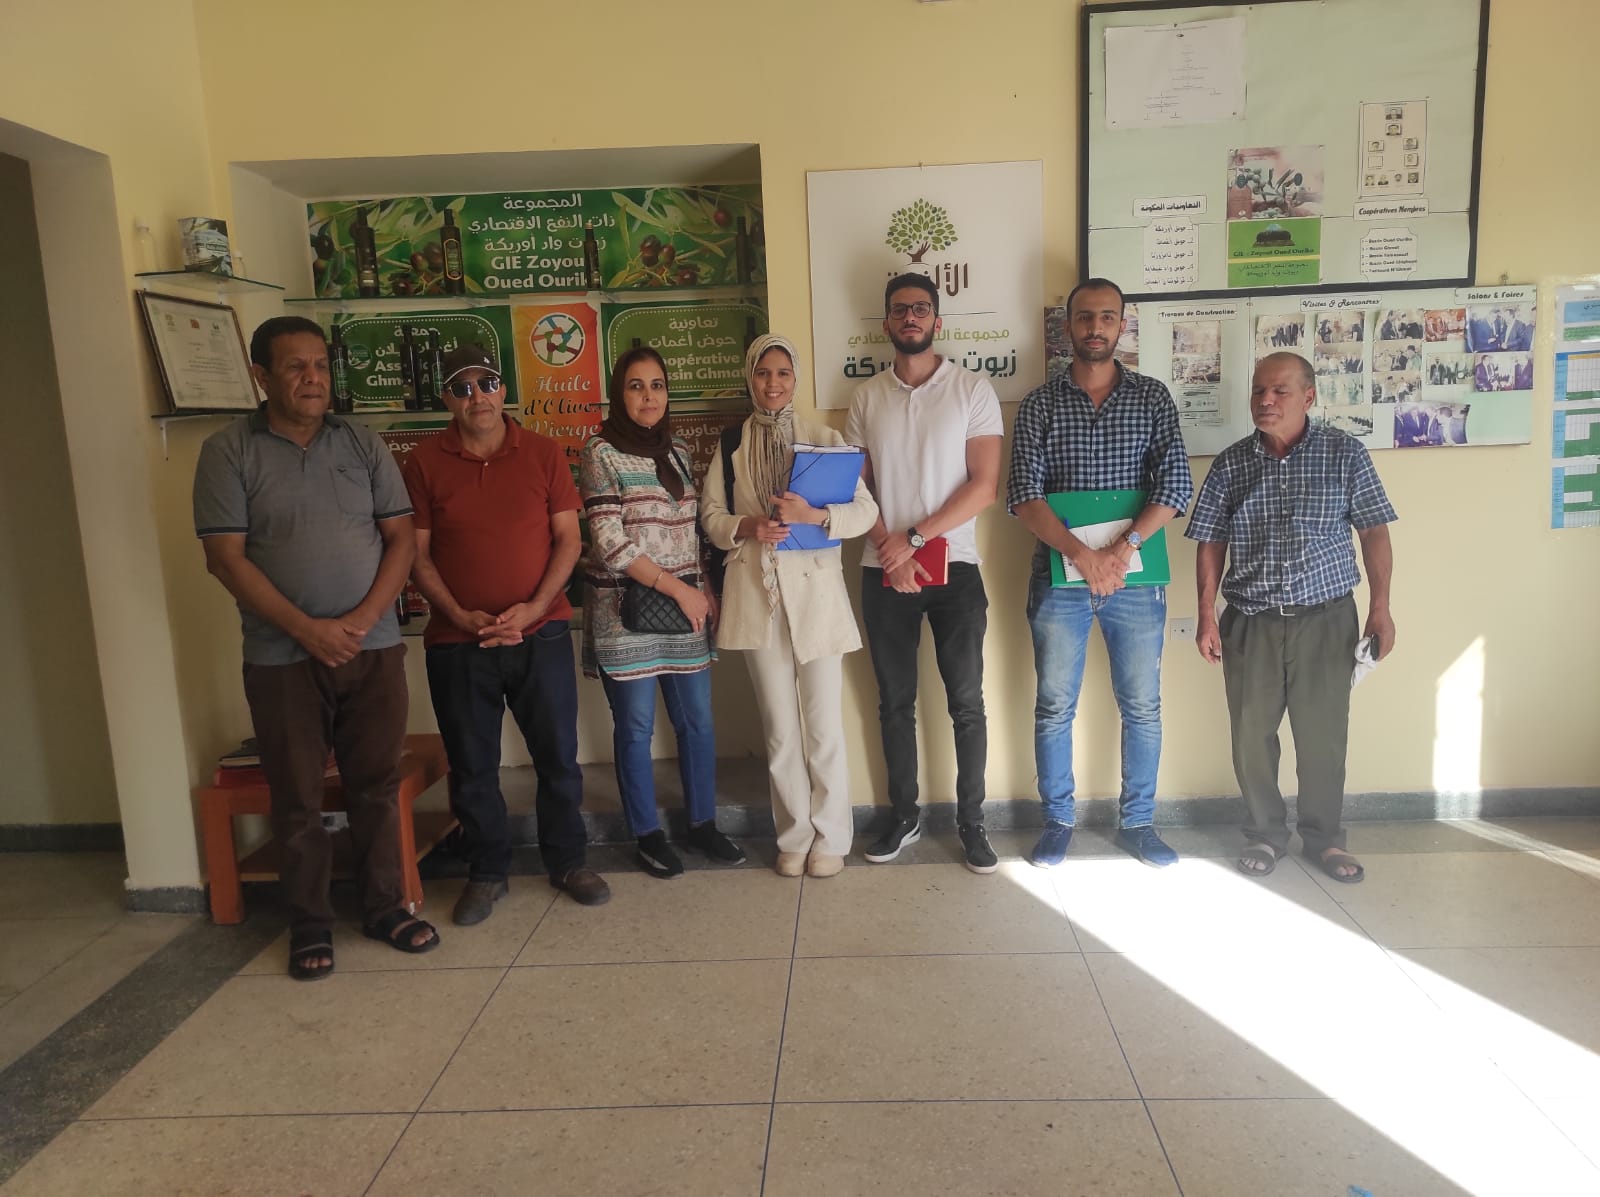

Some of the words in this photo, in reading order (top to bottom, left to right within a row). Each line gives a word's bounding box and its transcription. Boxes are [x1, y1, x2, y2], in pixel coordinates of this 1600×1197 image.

[503, 193, 582, 211] المجموعة
[467, 215, 541, 235] الاقتصادي
[546, 213, 583, 232] النفع
[484, 232, 536, 254] أوريكة
[568, 236, 607, 251] زت
[490, 255, 522, 270] GIE
[526, 255, 585, 272] Zoyou
[484, 273, 534, 289] Oued
[538, 271, 602, 289] Ourik
[668, 316, 719, 333] تعاونية
[648, 330, 692, 348] أغمات
[696, 334, 737, 349] حوض
[953, 327, 1010, 343] مجموعة
[663, 352, 740, 369] opérative
[963, 348, 1017, 378] زيوت
[366, 374, 403, 387] Ghm
[533, 374, 591, 393] Huile
